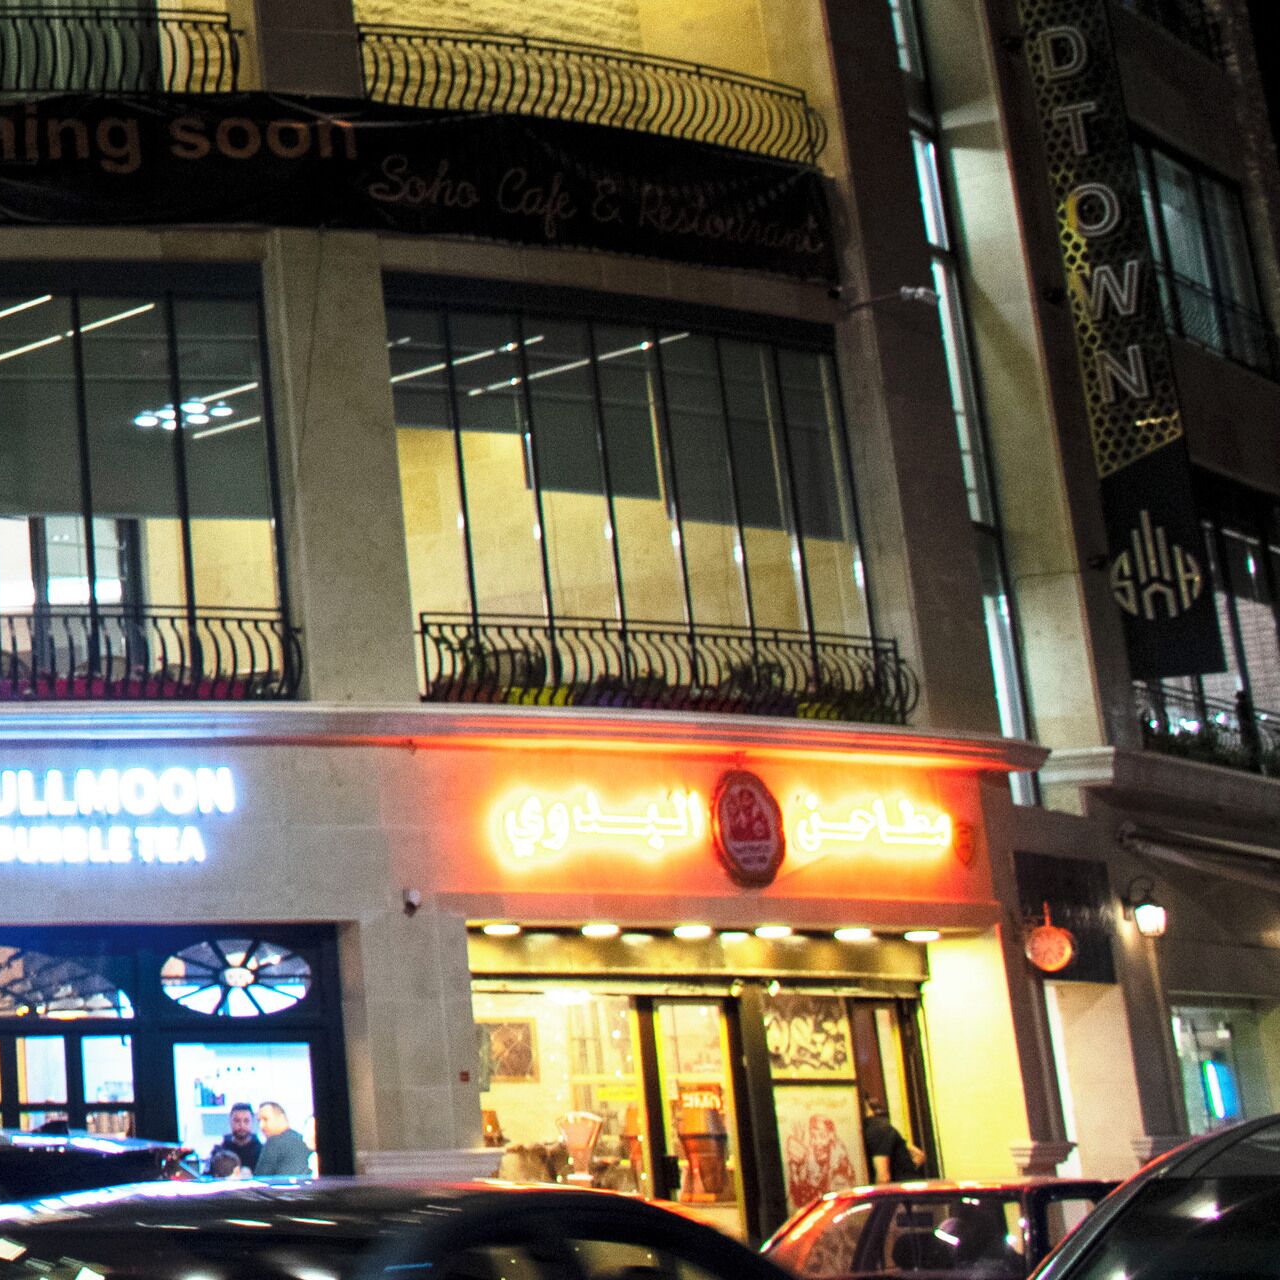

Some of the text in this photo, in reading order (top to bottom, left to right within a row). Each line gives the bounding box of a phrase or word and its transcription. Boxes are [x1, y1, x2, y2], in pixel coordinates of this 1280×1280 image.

[168, 115, 357, 161] soon
[368, 153, 481, 209] Soho
[134, 825, 207, 863] TEA
[504, 788, 706, 858] البدوي
